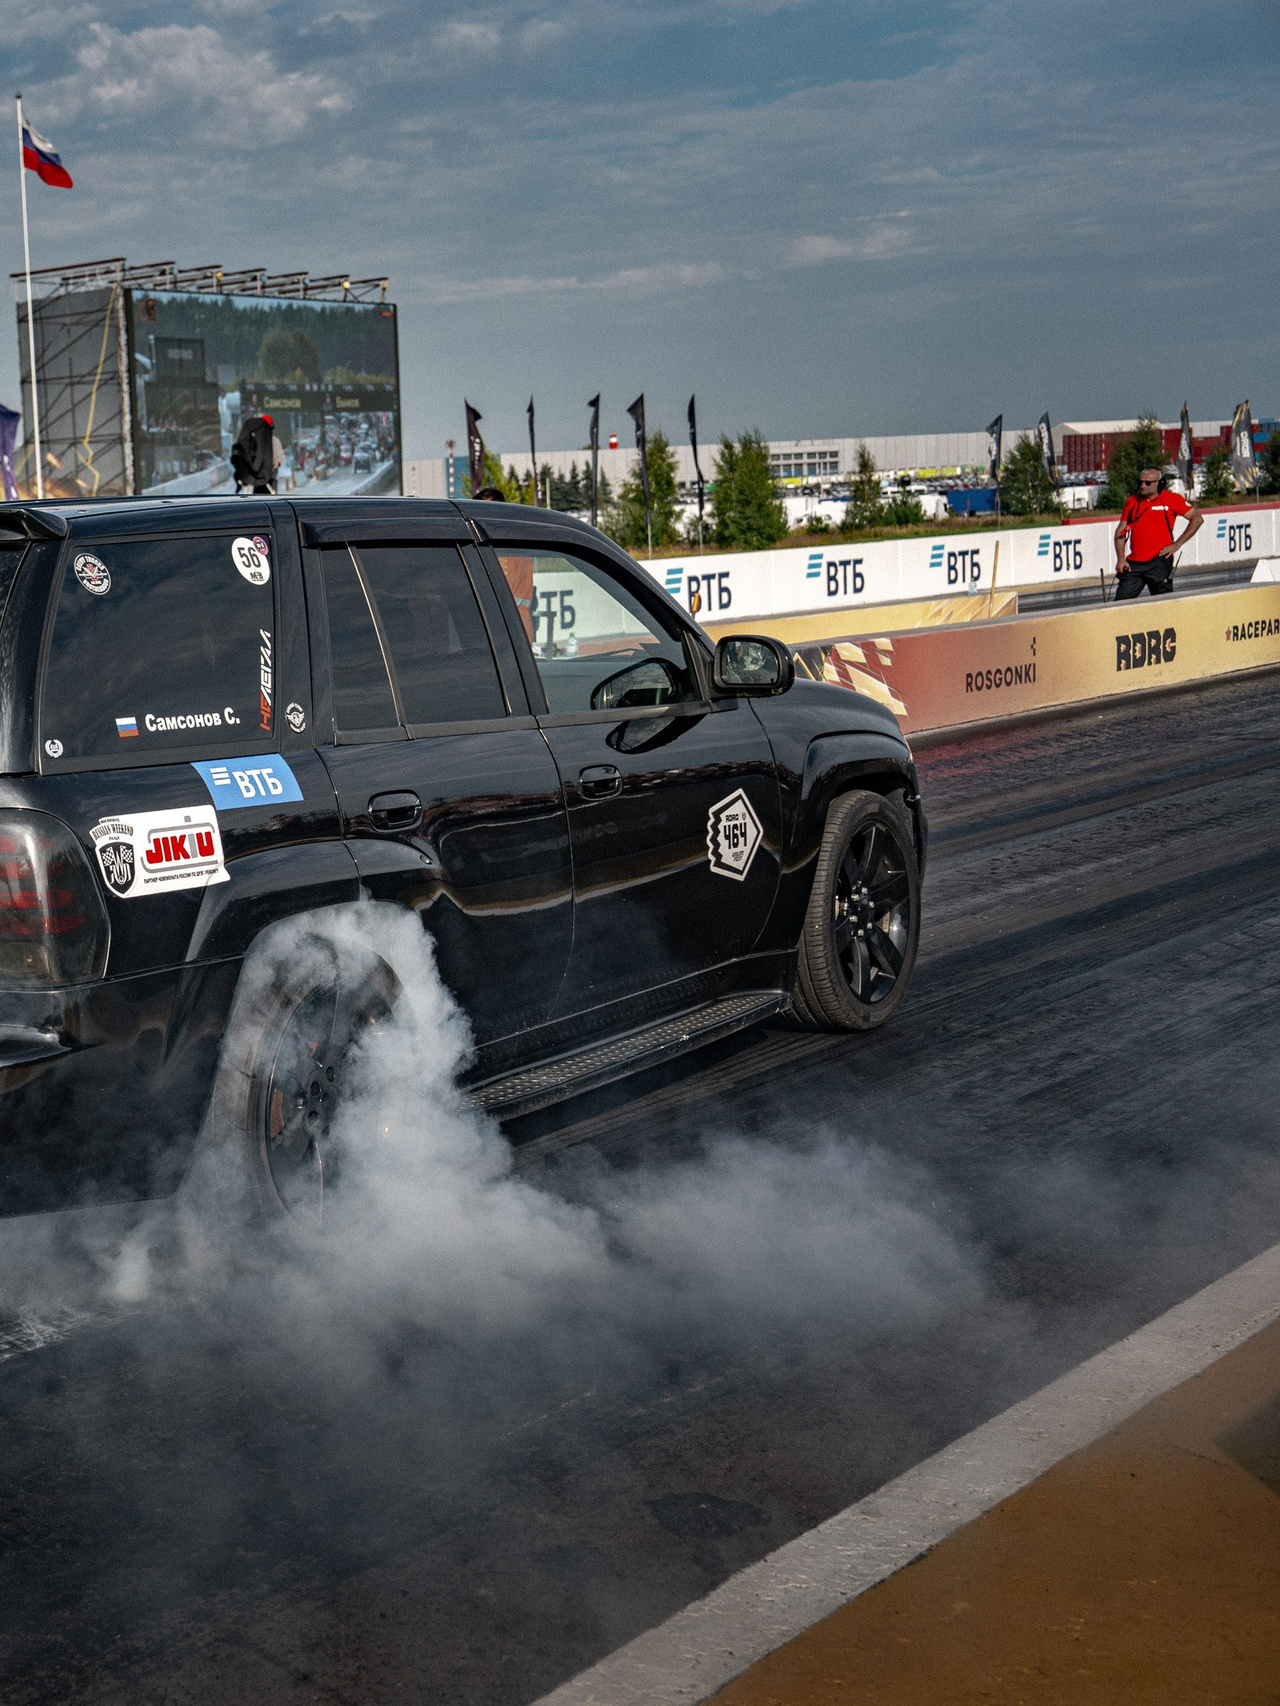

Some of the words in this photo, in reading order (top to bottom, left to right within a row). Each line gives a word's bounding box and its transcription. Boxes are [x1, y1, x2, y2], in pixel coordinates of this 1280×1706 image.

[1228, 523, 1252, 553] ВТБ
[237, 546, 262, 569] 56
[947, 548, 981, 585] ВТБ
[1053, 538, 1083, 573] ВТБ
[687, 571, 732, 614] ВТБ
[826, 558, 865, 597] ВТБ
[1115, 627, 1177, 672] RDRC
[965, 663, 1036, 693] ROSGONKI
[144, 712, 222, 732] Самсонов
[223, 707, 241, 725] С.
[231, 767, 283, 799] ВТБ
[145, 831, 215, 864] JIKIU
[723, 822, 748, 850] 464
